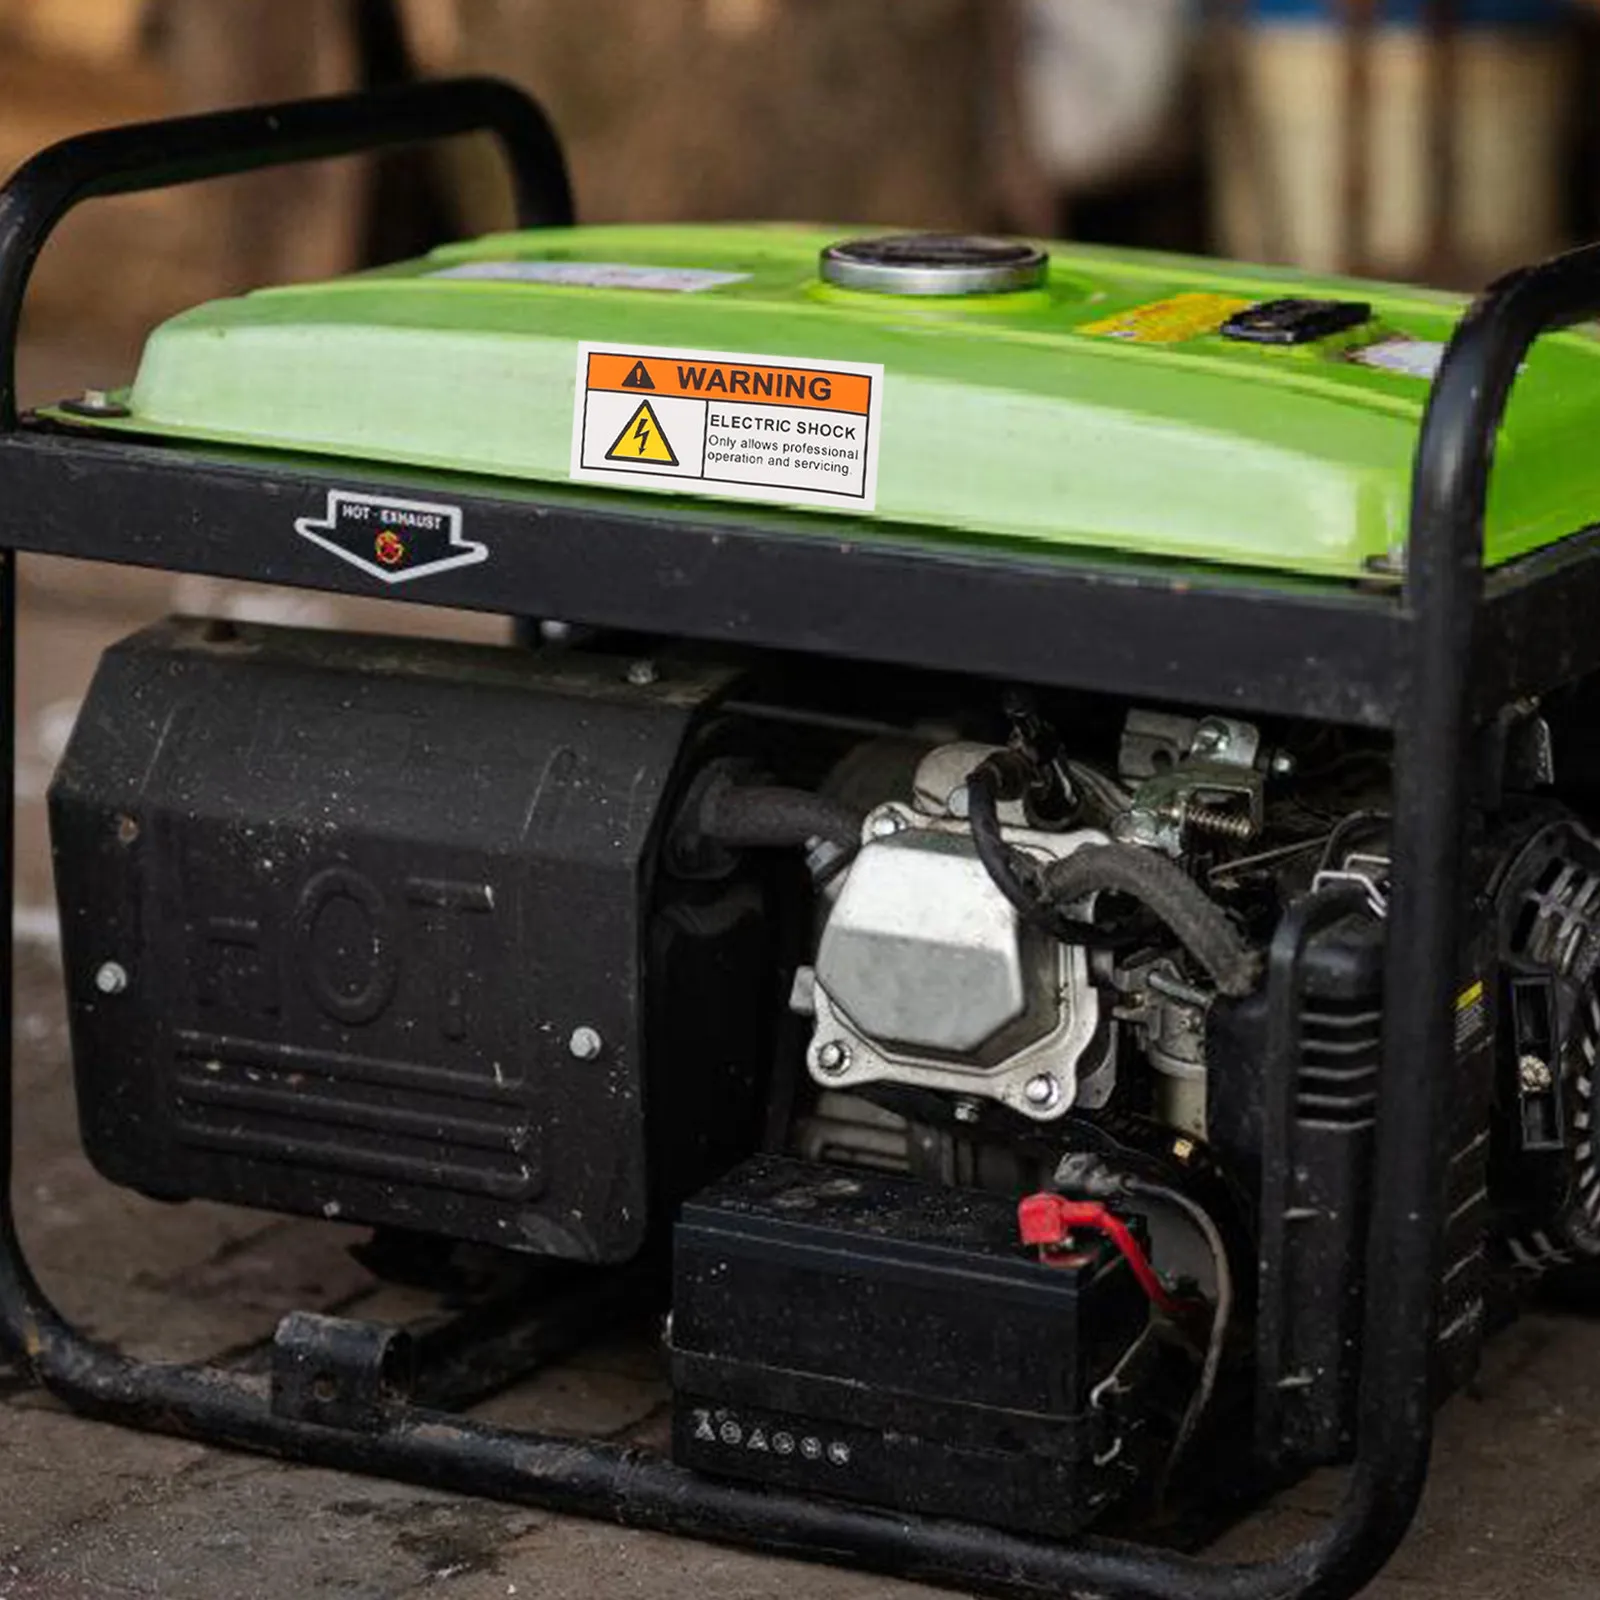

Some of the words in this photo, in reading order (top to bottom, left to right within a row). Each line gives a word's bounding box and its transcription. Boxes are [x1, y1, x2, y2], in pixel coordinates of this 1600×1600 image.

[677, 366, 832, 401] WARNING
[710, 414, 791, 433] ELECTRIC
[796, 421, 856, 440] SHOCK
[707, 451, 763, 464] operation
[768, 456, 790, 467] and
[708, 434, 737, 450] Only
[740, 436, 779, 451] allows
[782, 442, 859, 460] professional
[342, 504, 370, 519] HOT
[381, 509, 442, 530] EXHAUST
